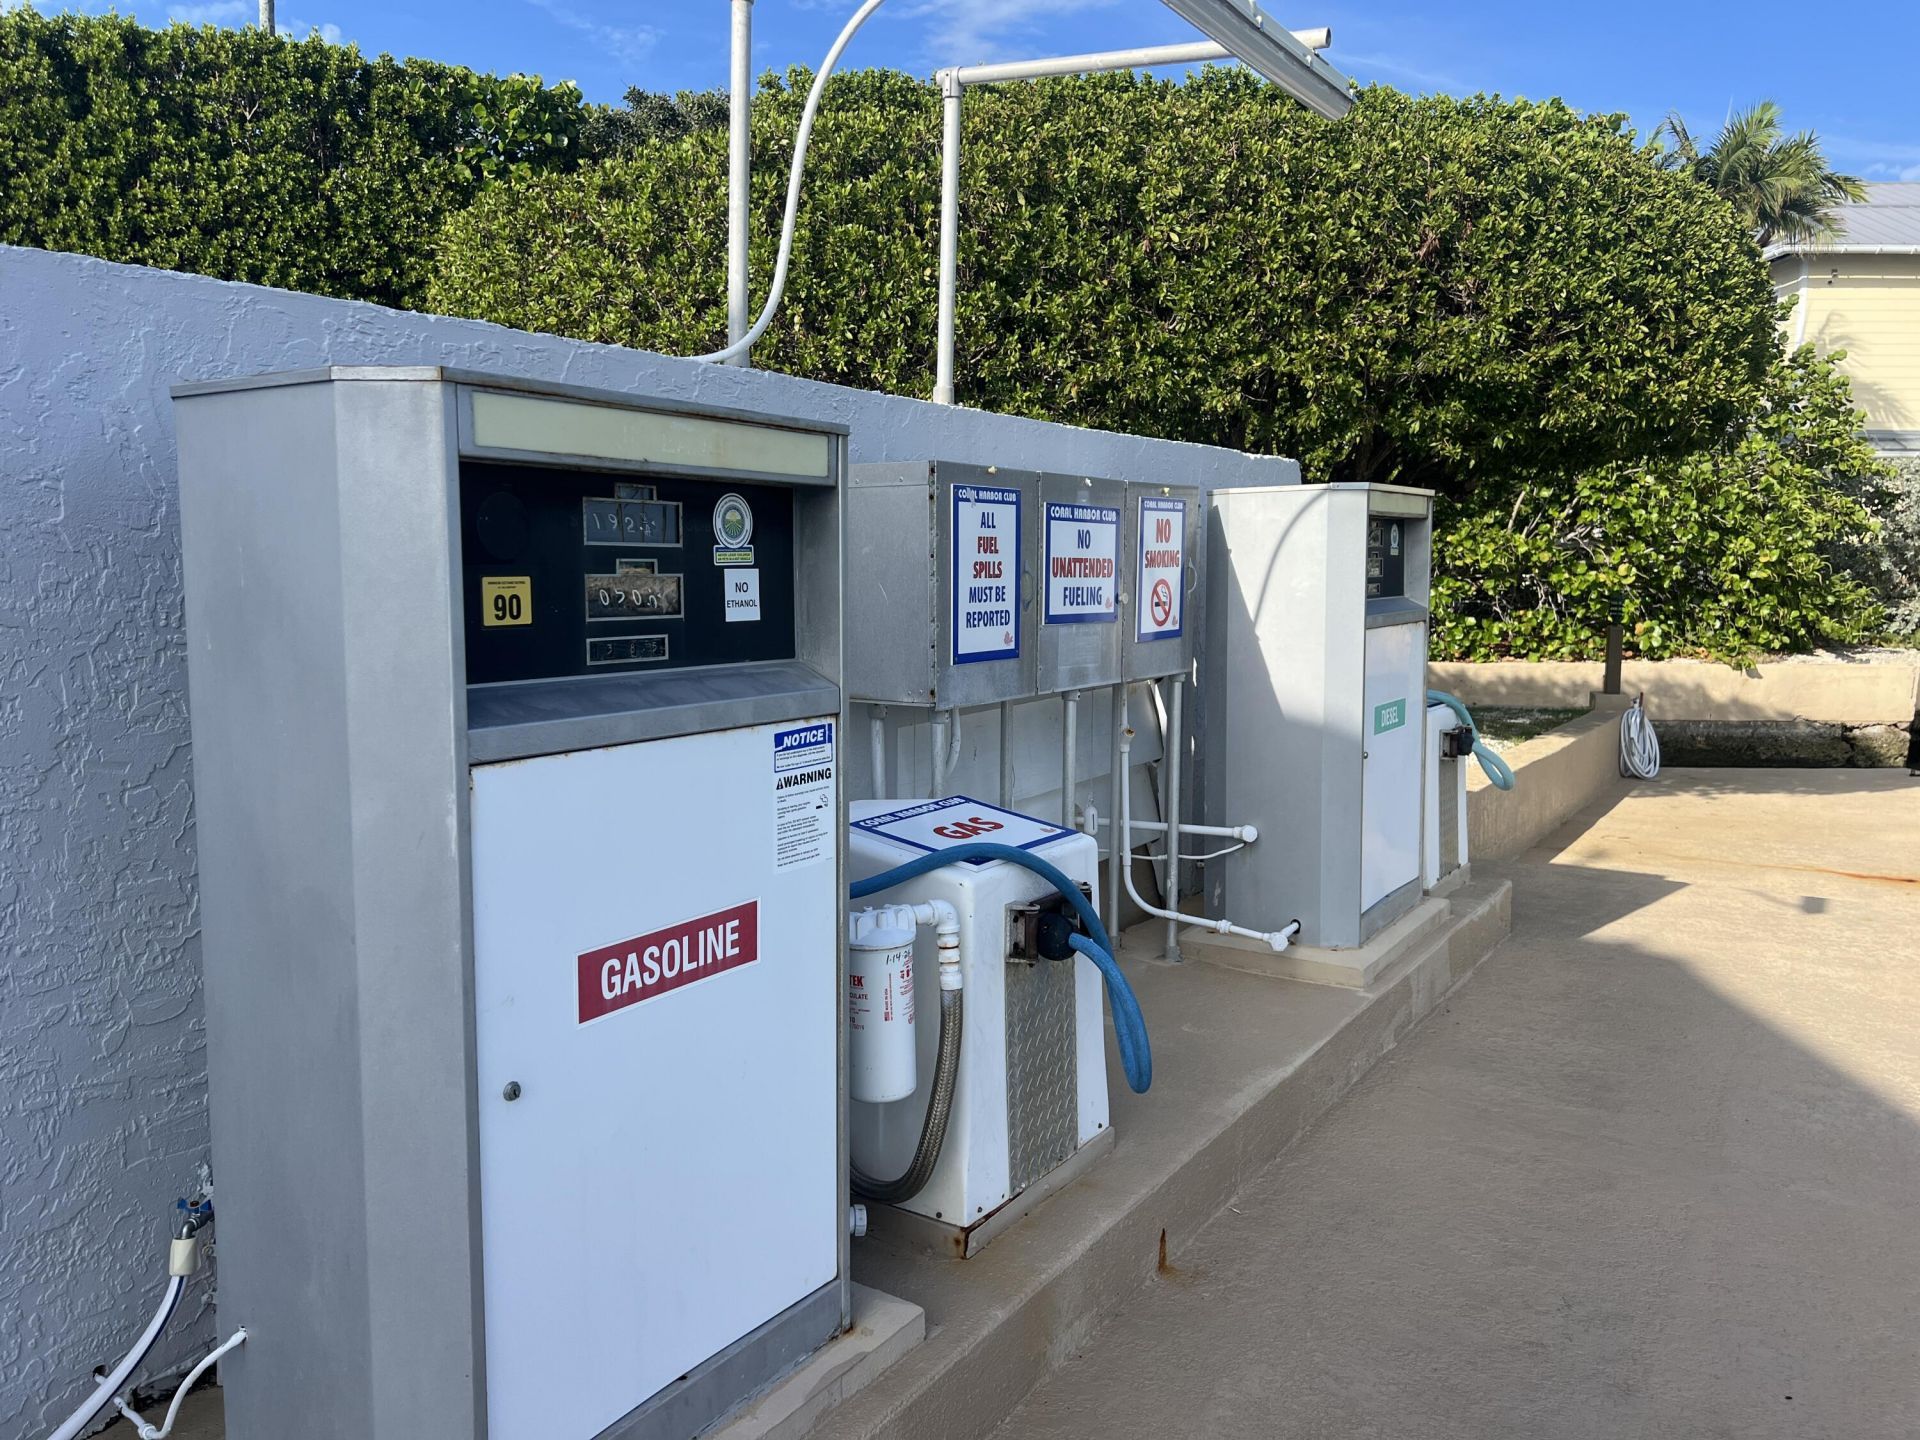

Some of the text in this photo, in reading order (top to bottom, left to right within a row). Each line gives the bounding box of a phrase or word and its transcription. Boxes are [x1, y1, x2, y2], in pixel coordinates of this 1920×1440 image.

[979, 490, 1002, 501] HARBOR
[1003, 492, 1017, 502] CLUB
[980, 511, 996, 529] ALL
[1050, 505, 1117, 522] CORAL HARBOR CLUB
[1077, 529, 1091, 549] NO
[1156, 518, 1171, 543] NO
[977, 536, 999, 554] FUEL
[1052, 557, 1114, 578] UNATTENDED
[1145, 550, 1180, 568] SMOKING
[973, 561, 1003, 579] SPILLS
[735, 582, 749, 593] NO
[968, 585, 1006, 604] MUST BE
[1063, 586, 1103, 607] FUELING
[493, 593, 522, 621] 90
[726, 599, 758, 609] ETHANOL
[965, 609, 1011, 629] REPORTED
[1381, 705, 1399, 728] DIESEL
[783, 728, 825, 748] NOTICE
[783, 767, 832, 789] WARNING
[859, 813, 899, 827] CORAL
[933, 816, 1004, 839] GAS
[601, 918, 740, 1000] GASOLINE
